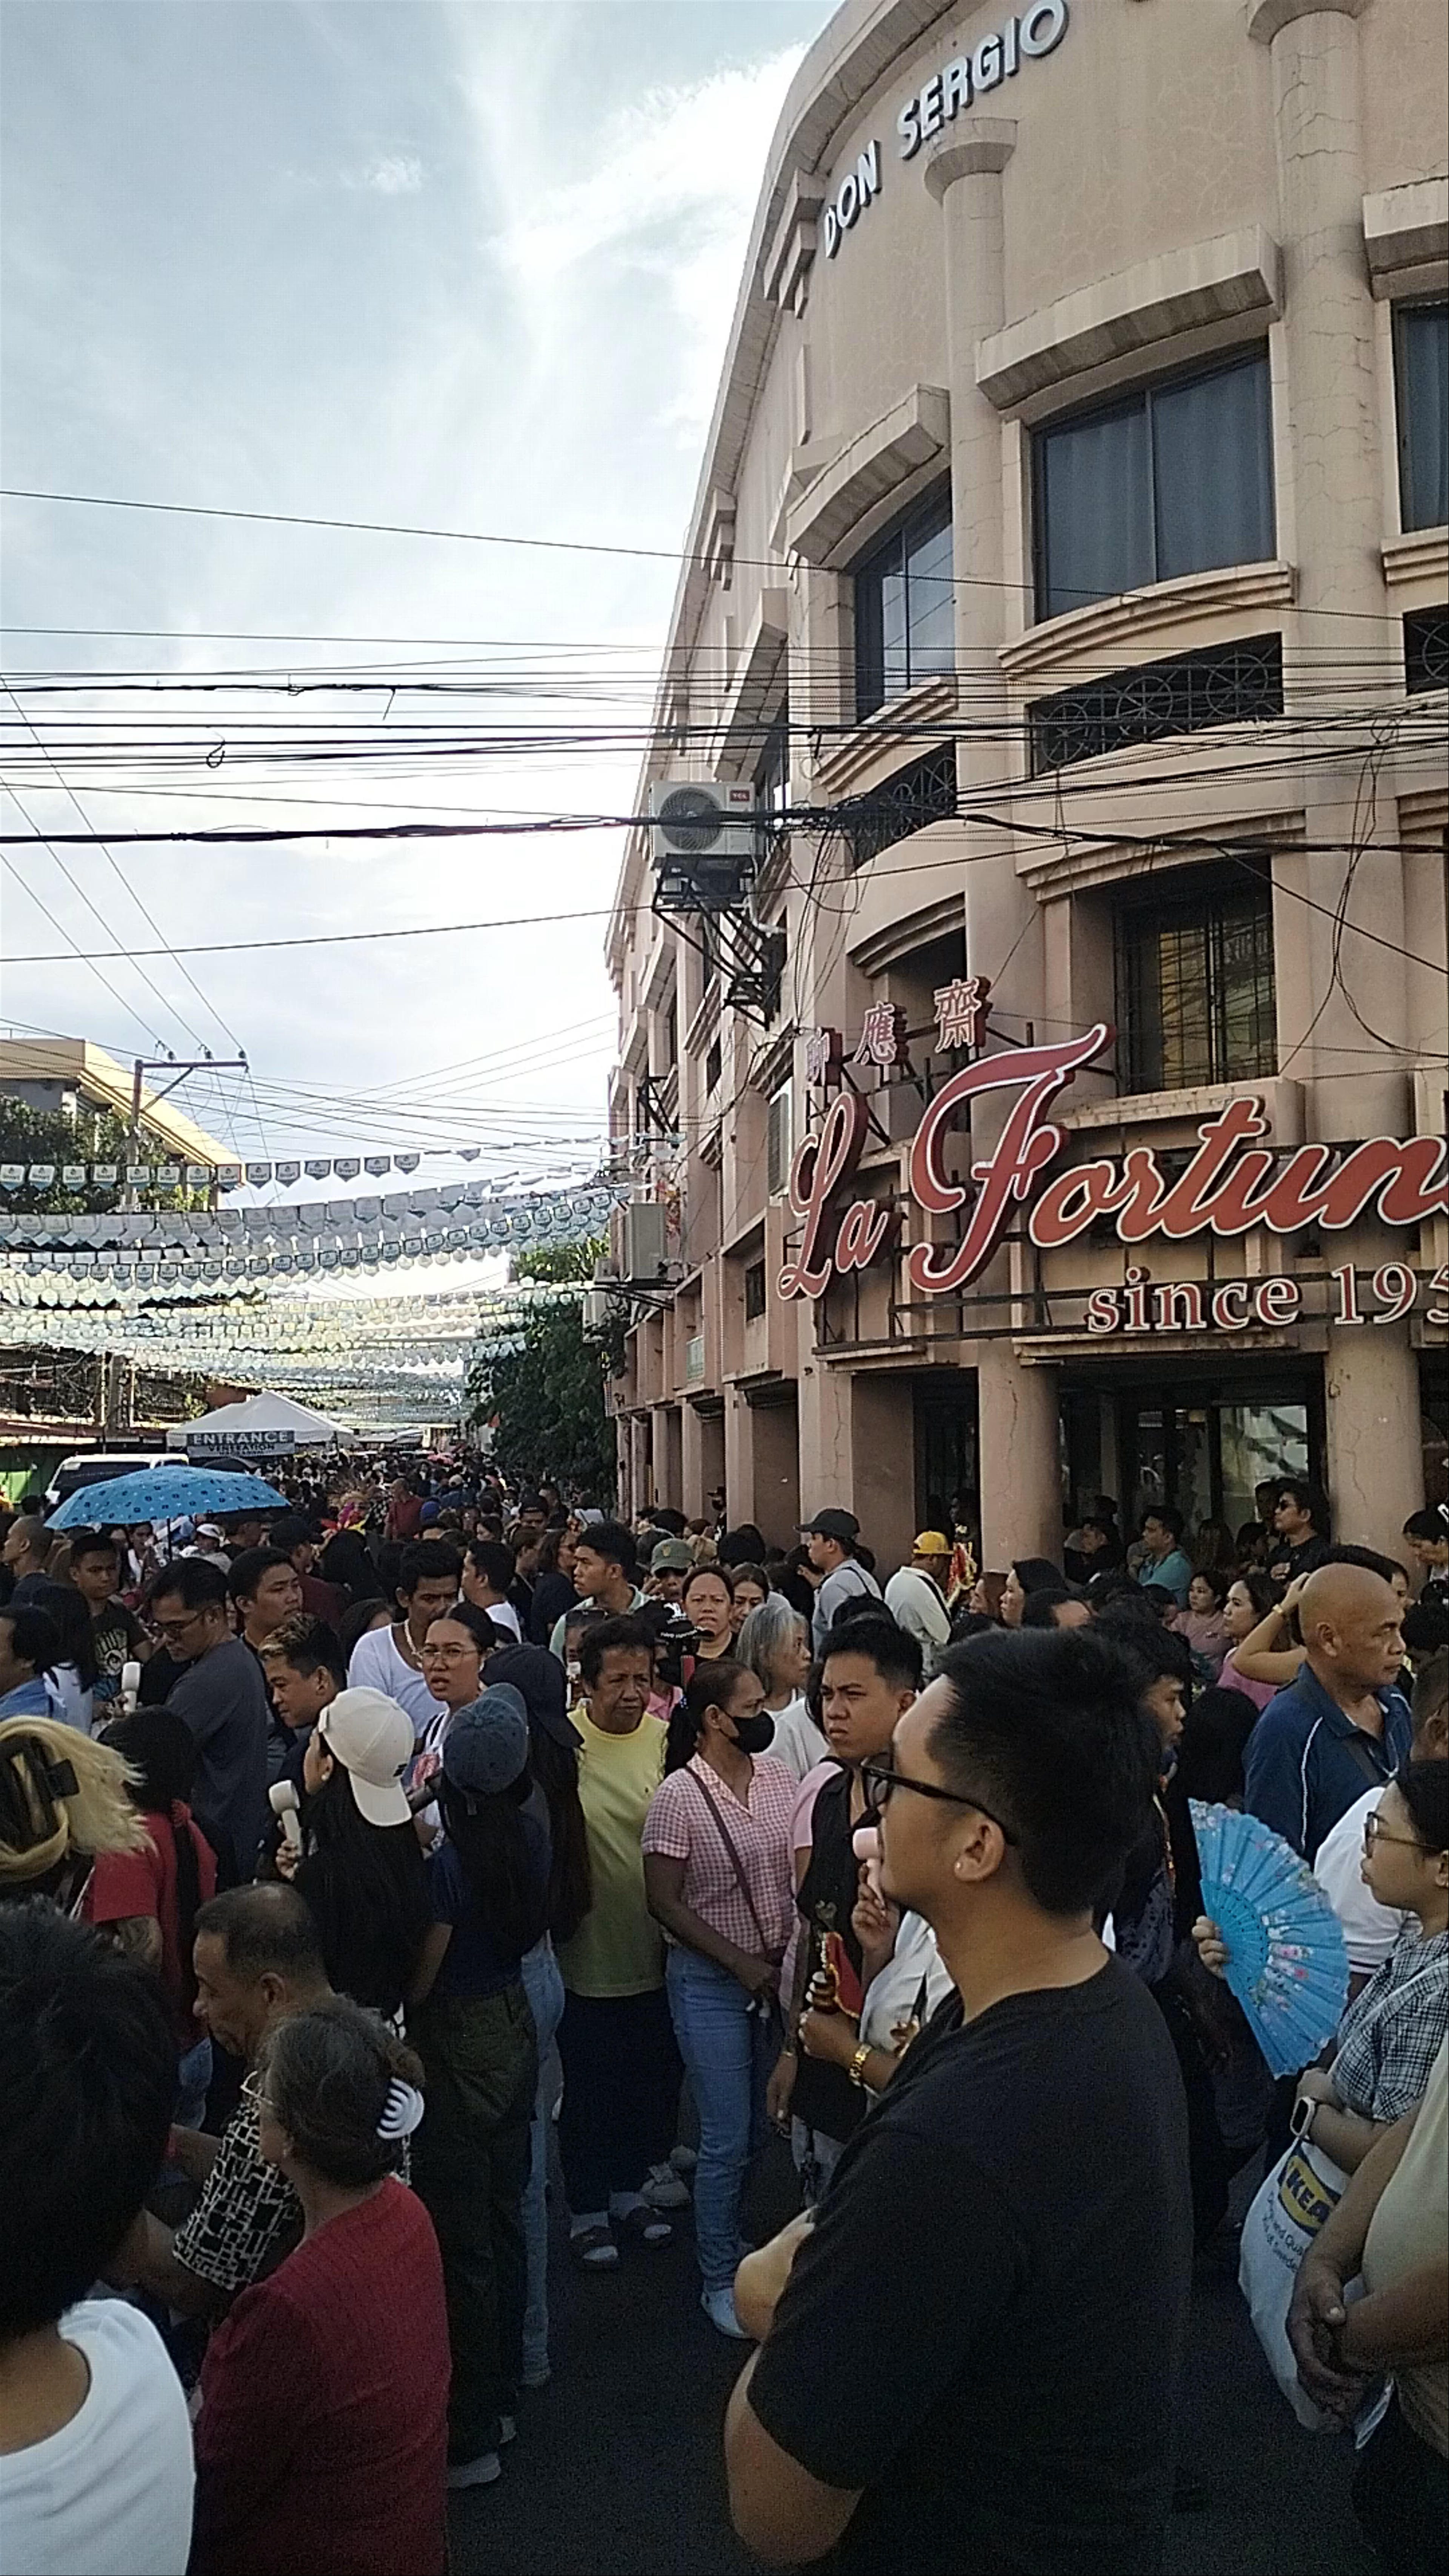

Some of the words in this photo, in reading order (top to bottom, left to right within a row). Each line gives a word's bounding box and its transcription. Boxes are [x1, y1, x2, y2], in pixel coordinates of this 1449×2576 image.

[824, 140, 882, 259] DON
[897, 0, 1069, 160] SERGIO
[777, 1091, 889, 1301] La
[909, 1023, 1449, 1293] Fortun
[1087, 1267, 1300, 1333] since
[193, 1431, 288, 1445] ENTRANCE
